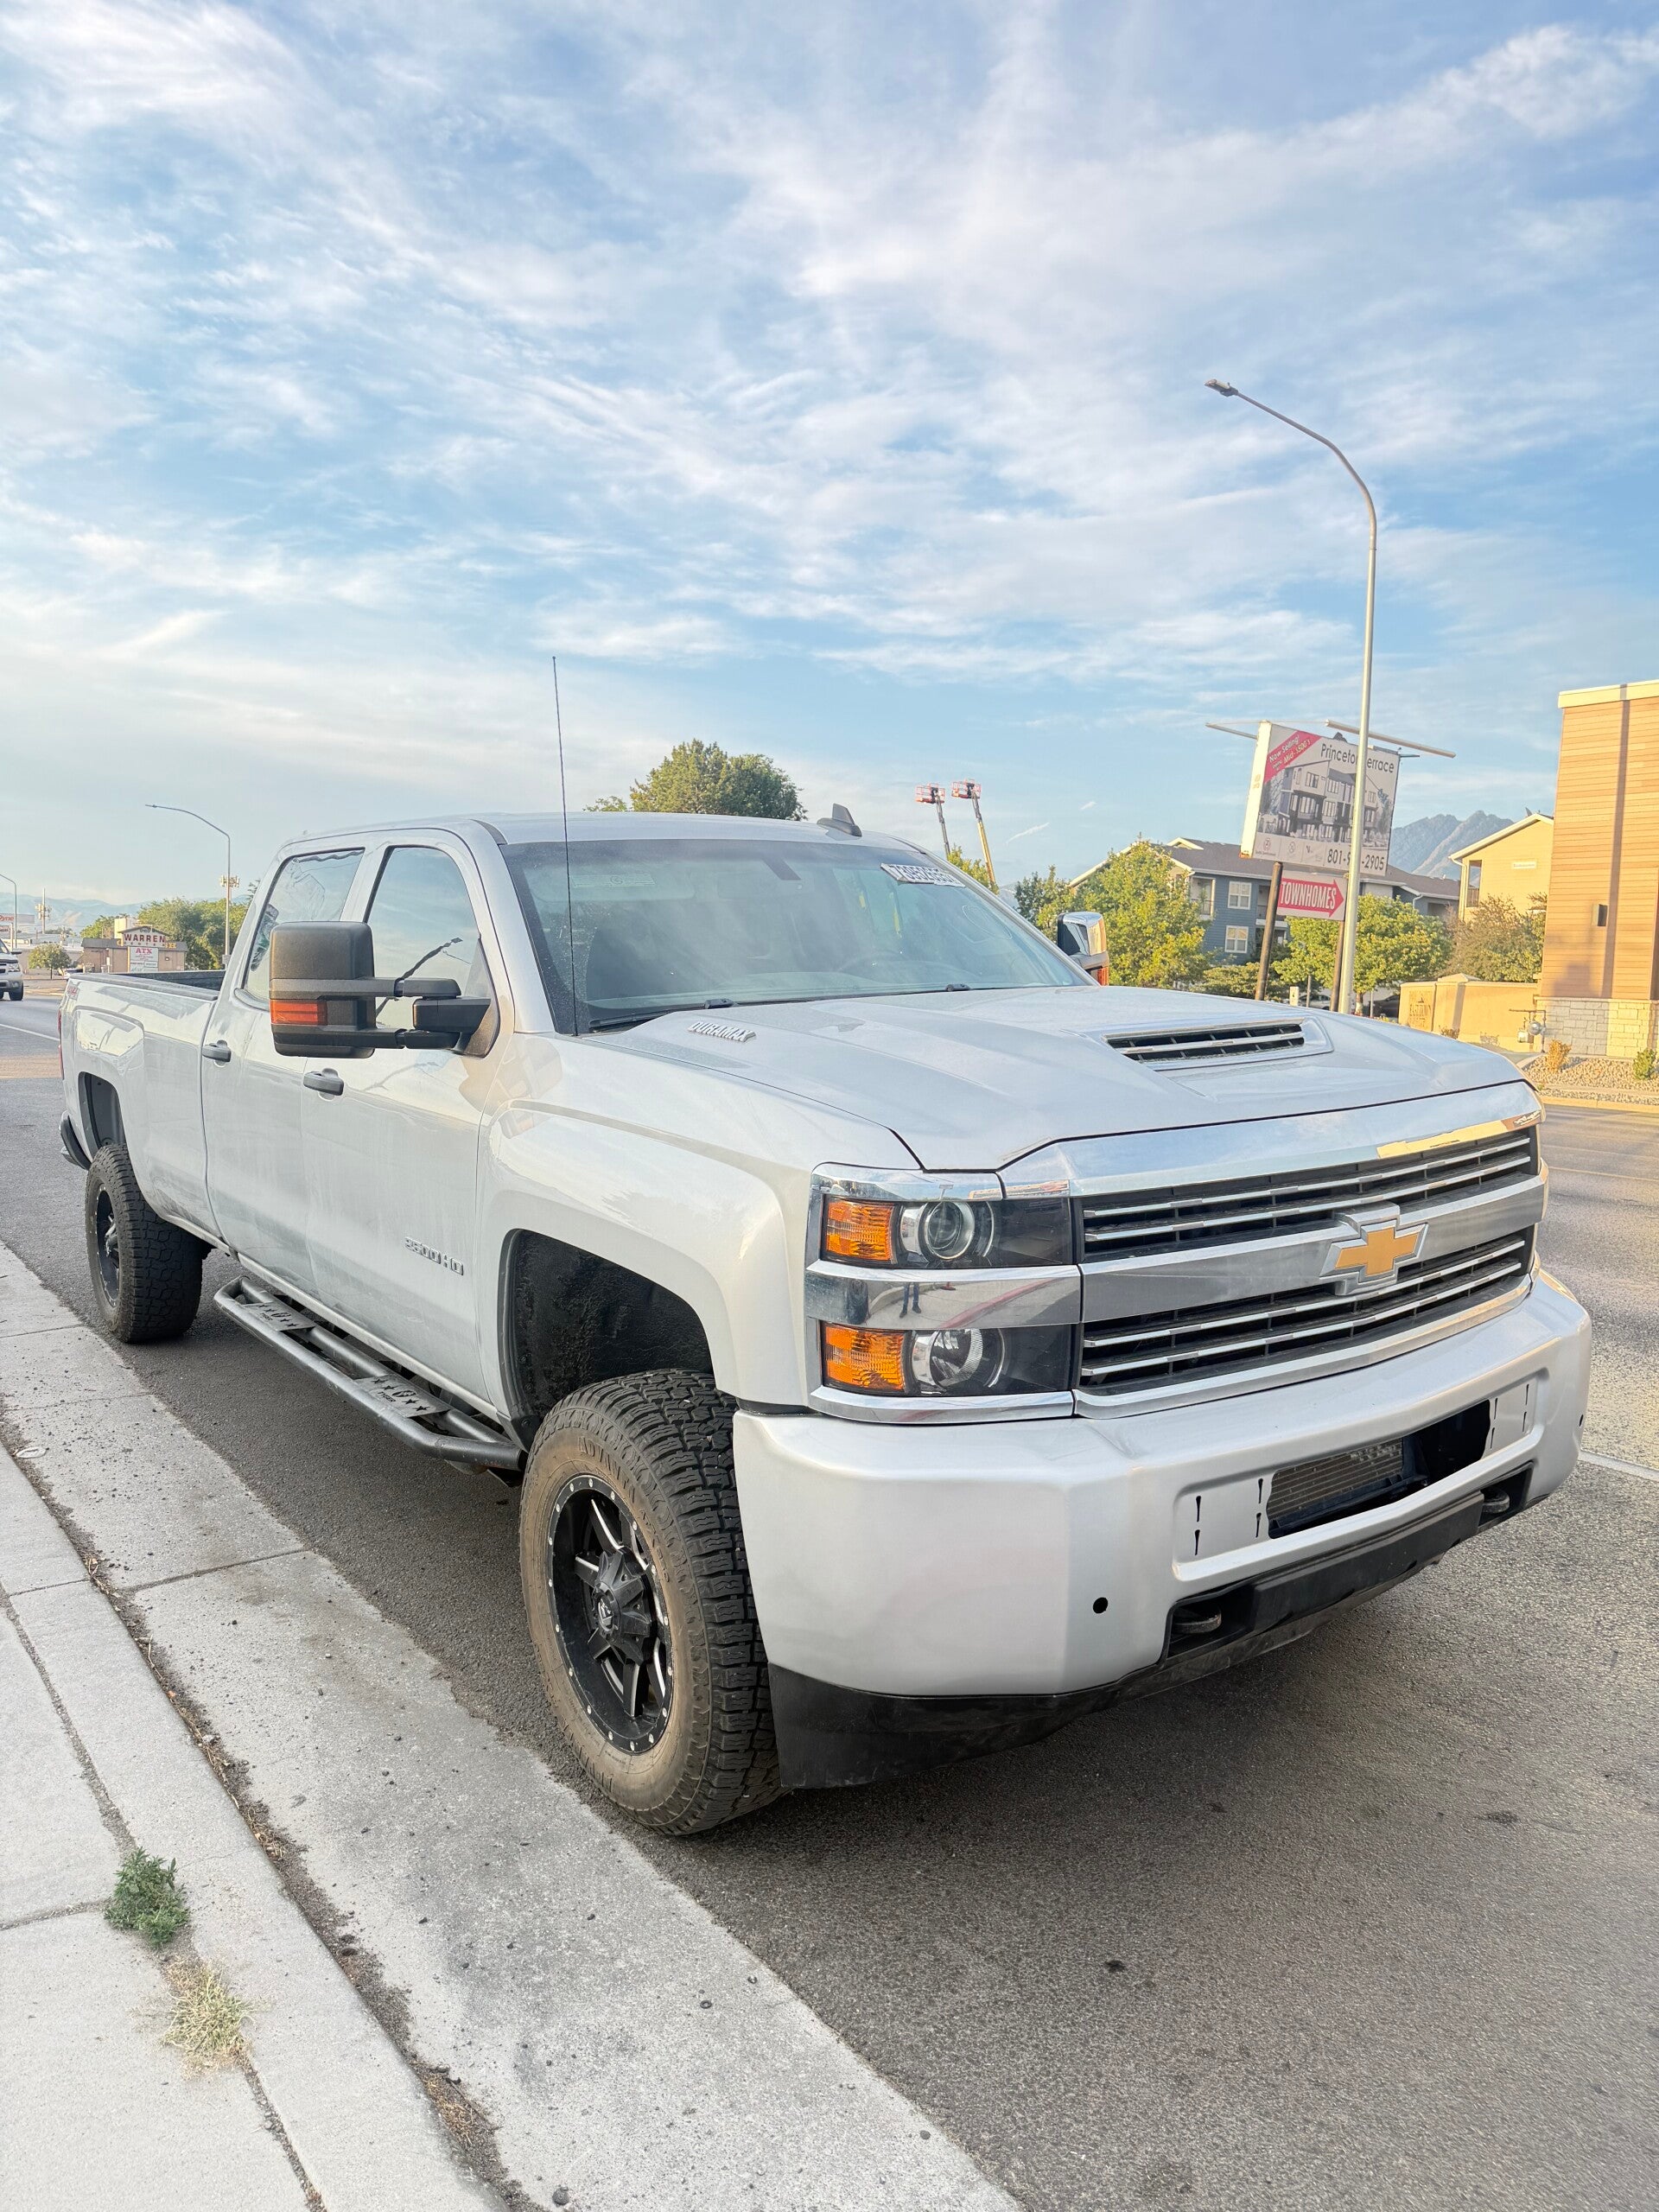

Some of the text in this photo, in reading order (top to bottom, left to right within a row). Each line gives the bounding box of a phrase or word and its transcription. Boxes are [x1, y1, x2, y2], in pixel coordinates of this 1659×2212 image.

[1320, 743, 1395, 773] Princeto errace
[1281, 881, 1337, 910] TOWNHOMES
[124, 933, 166, 943] WARREN
[688, 1020, 757, 1043] DURAMAX
